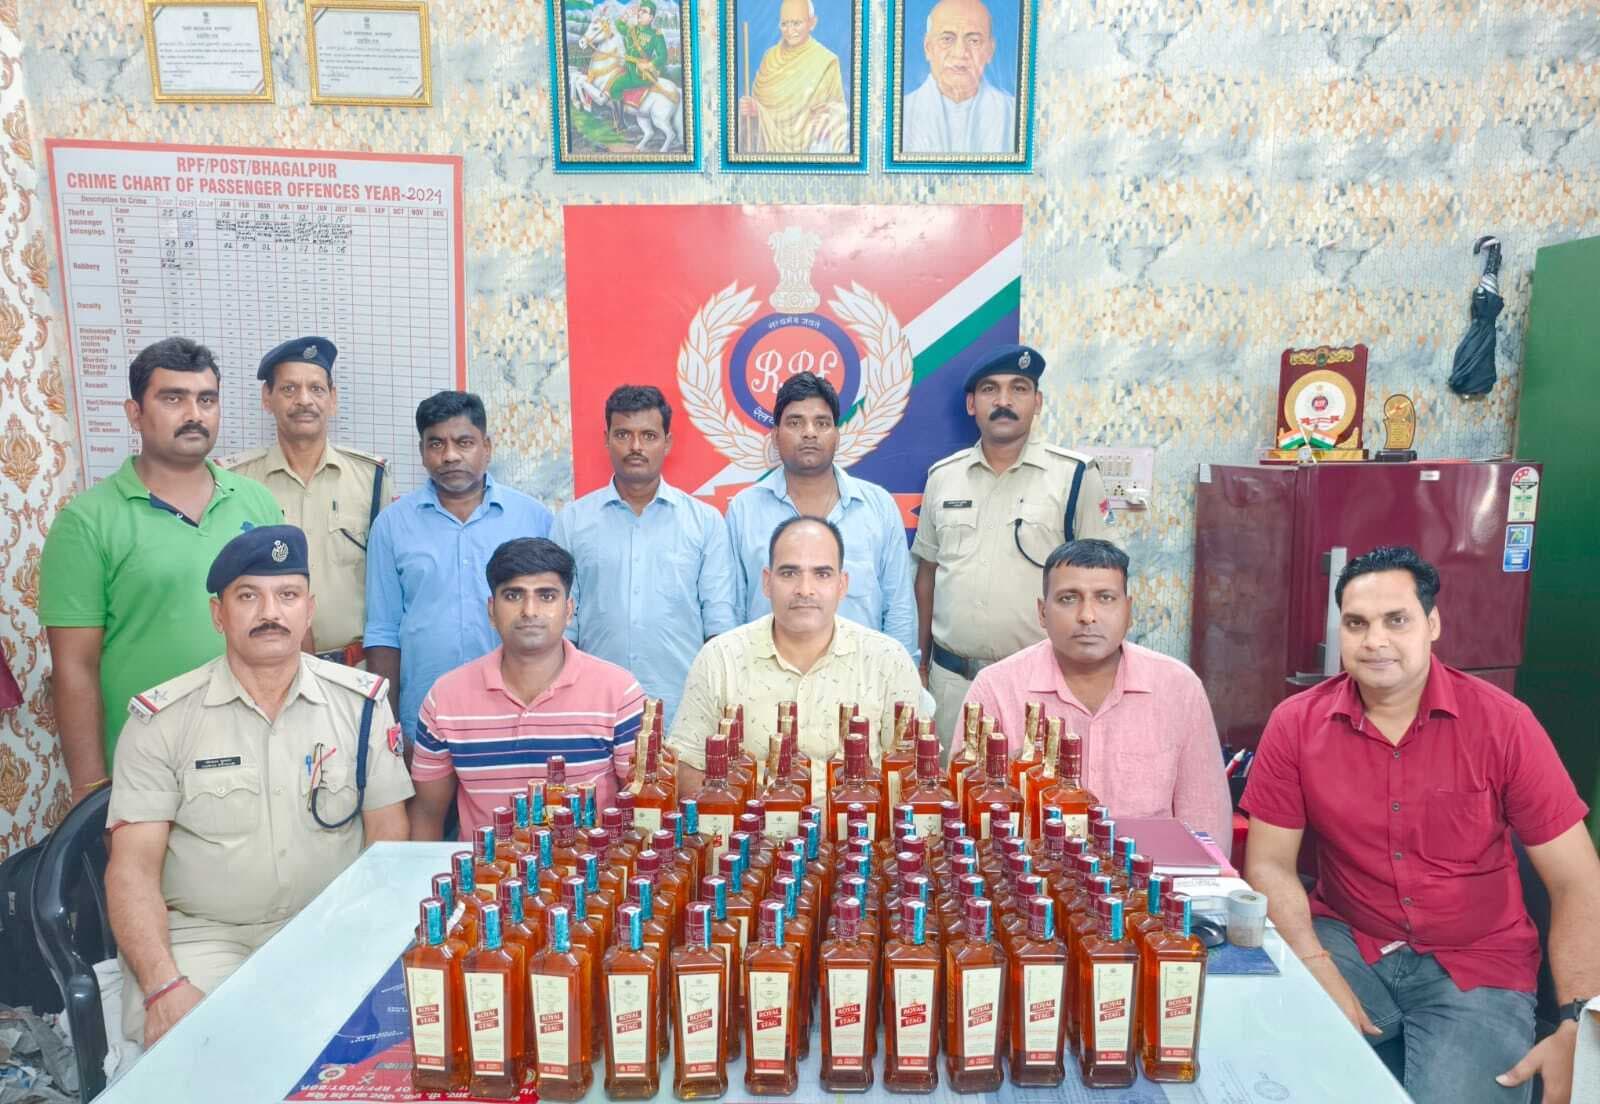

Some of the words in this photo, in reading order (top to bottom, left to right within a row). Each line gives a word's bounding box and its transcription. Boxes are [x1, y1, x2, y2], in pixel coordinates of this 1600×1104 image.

[177, 157, 337, 178] RPF/POST/BHAGALPUR
[67, 173, 117, 190] CRIME
[122, 175, 171, 192] CHART
[176, 178, 194, 193] OF
[200, 179, 282, 196] PASSENGER
[287, 182, 360, 200] OFFENCES
[1031, 1001, 1053, 1010] ROYAL
[1101, 1000, 1123, 1009] ROYAL
[1167, 998, 1190, 1008] ROYAL
[417, 1005, 438, 1014] ROYAL
[758, 1009, 780, 1018] ROYAL
[837, 1005, 858, 1015] ROYAL
[902, 1005, 925, 1015] ROYAL
[970, 1004, 992, 1015] ROYAL
[1169, 1007, 1189, 1016] STAG
[475, 1010, 497, 1019] ROYAL
[541, 1013, 562, 1023] ROYAL
[618, 1012, 640, 1021] ROYAL
[688, 1011, 711, 1021] ROYAL
[1034, 1011, 1052, 1020] STAG
[1104, 1010, 1122, 1019] STAG
[419, 1016, 437, 1025] STAG
[478, 1020, 496, 1029] STAG
[760, 1019, 778, 1028] STAG
[839, 1017, 857, 1026] STAG
[904, 1017, 922, 1026] STAG
[972, 1015, 990, 1025] STAG
[543, 1024, 561, 1033] STAG
[621, 1022, 639, 1031] STAG
[691, 1022, 709, 1031] STAG
